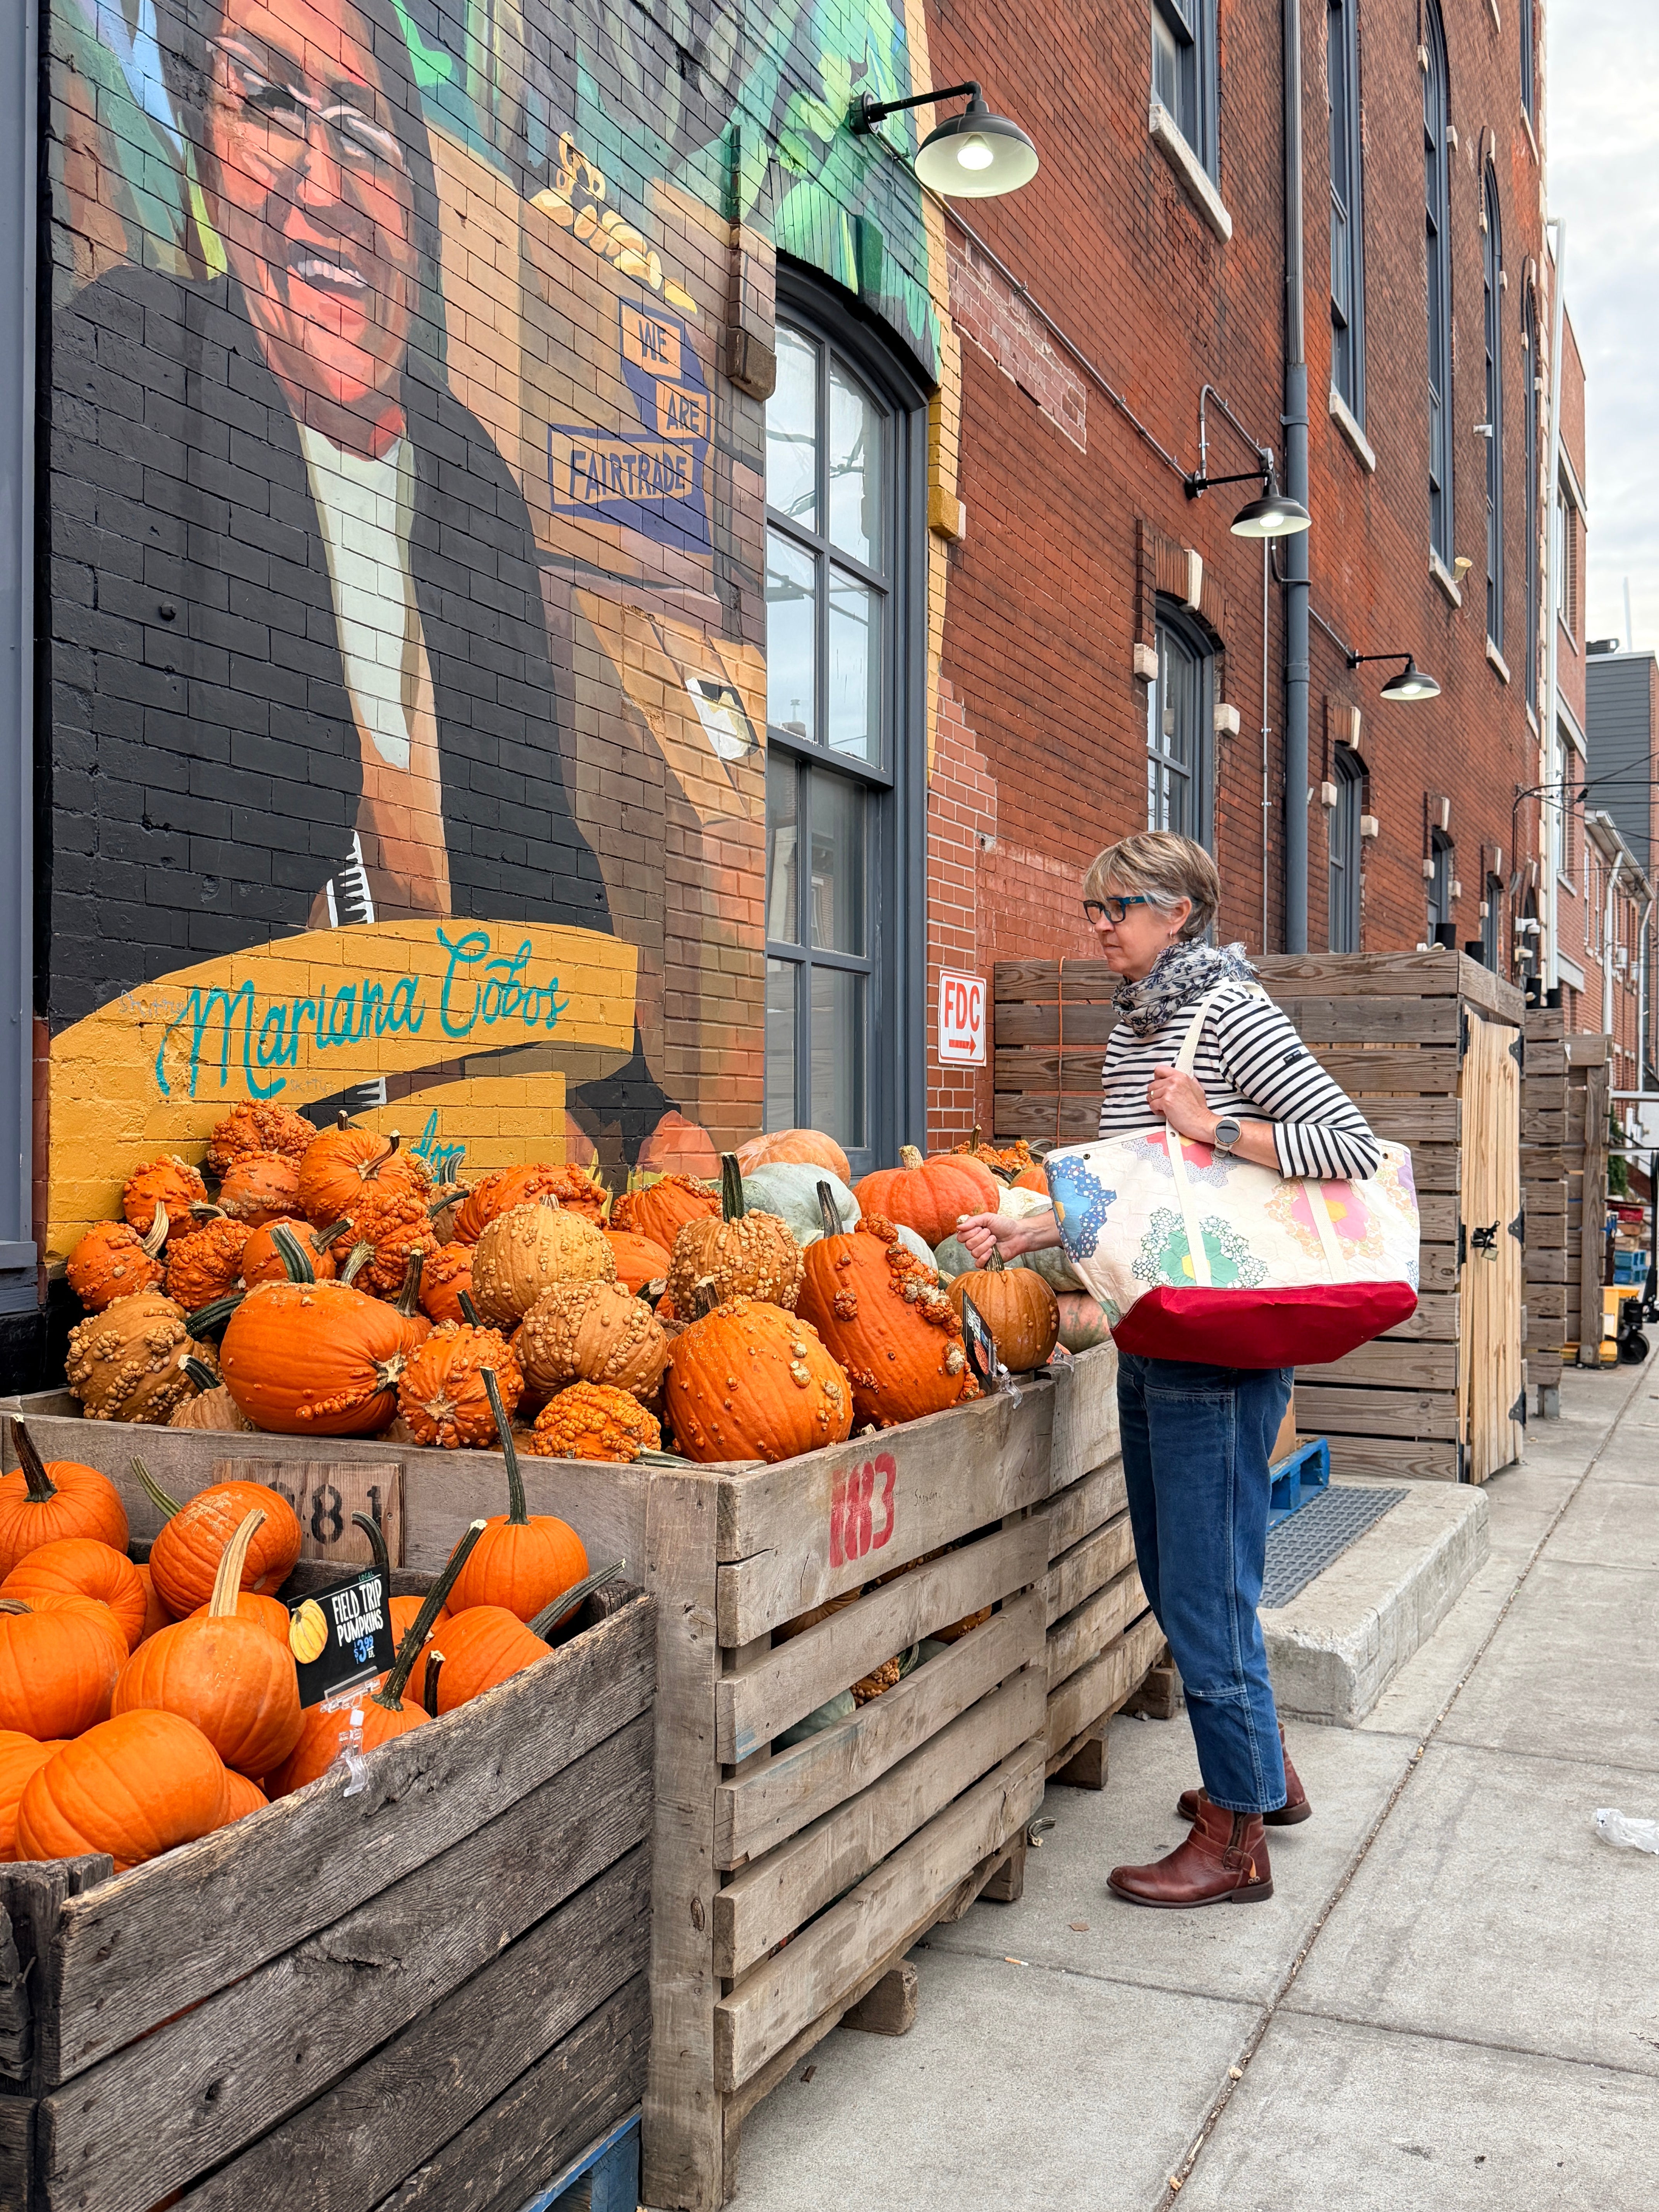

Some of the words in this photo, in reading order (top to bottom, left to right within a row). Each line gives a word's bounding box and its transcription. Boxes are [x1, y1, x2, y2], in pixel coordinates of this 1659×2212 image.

[638, 319, 669, 364] WE
[666, 391, 699, 432] ARE
[569, 450, 687, 500] FAIRTRADE
[944, 981, 980, 1032] FDC
[156, 974, 425, 1099] Mariana
[358, 1571, 374, 1582] LOCAL
[331, 1589, 360, 1625] FIELD
[359, 1579, 382, 1613] TRIP
[337, 1609, 383, 1647] PUMPKINS
